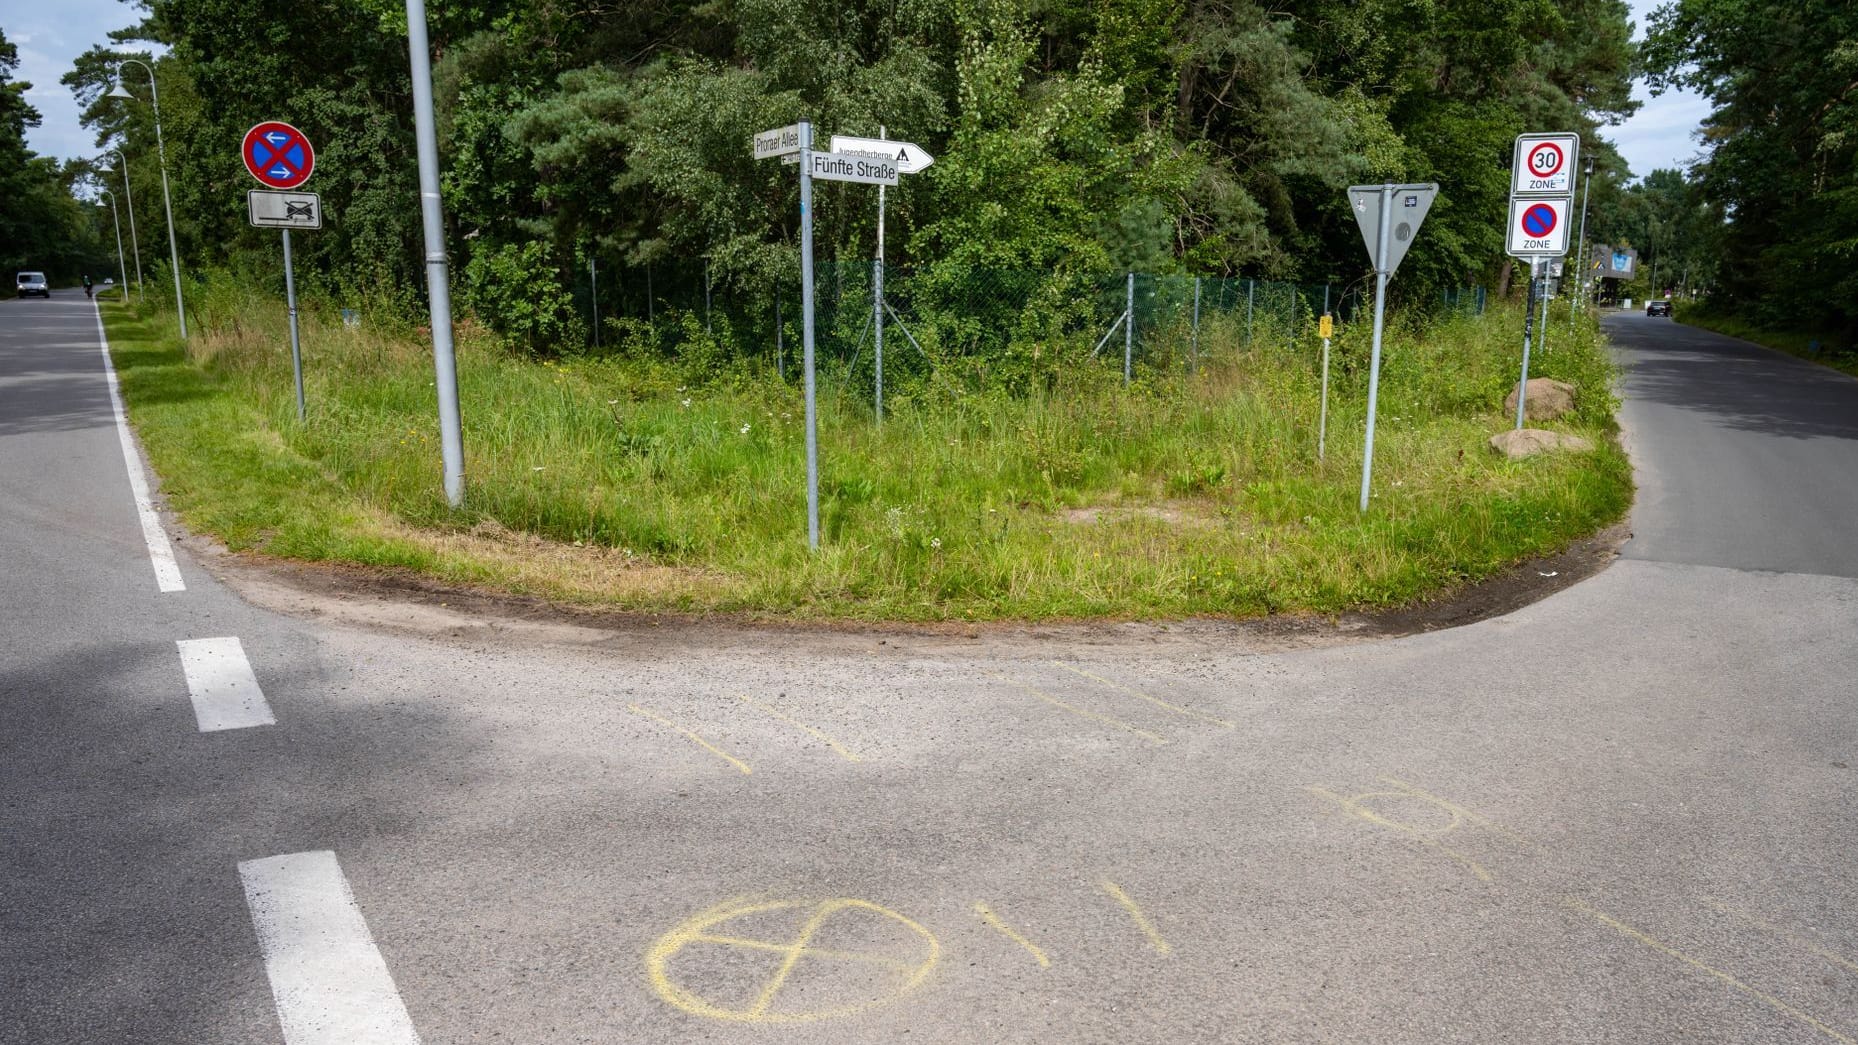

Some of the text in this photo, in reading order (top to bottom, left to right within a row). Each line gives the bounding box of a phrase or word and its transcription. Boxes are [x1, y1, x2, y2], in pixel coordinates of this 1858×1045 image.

[756, 132, 799, 153] Proraer Allee
[815, 156, 853, 175] Fünfte
[857, 160, 895, 180] Straße
[1534, 152, 1556, 169] 30
[1530, 180, 1556, 189] ZONE
[1523, 240, 1551, 249] ZONE
